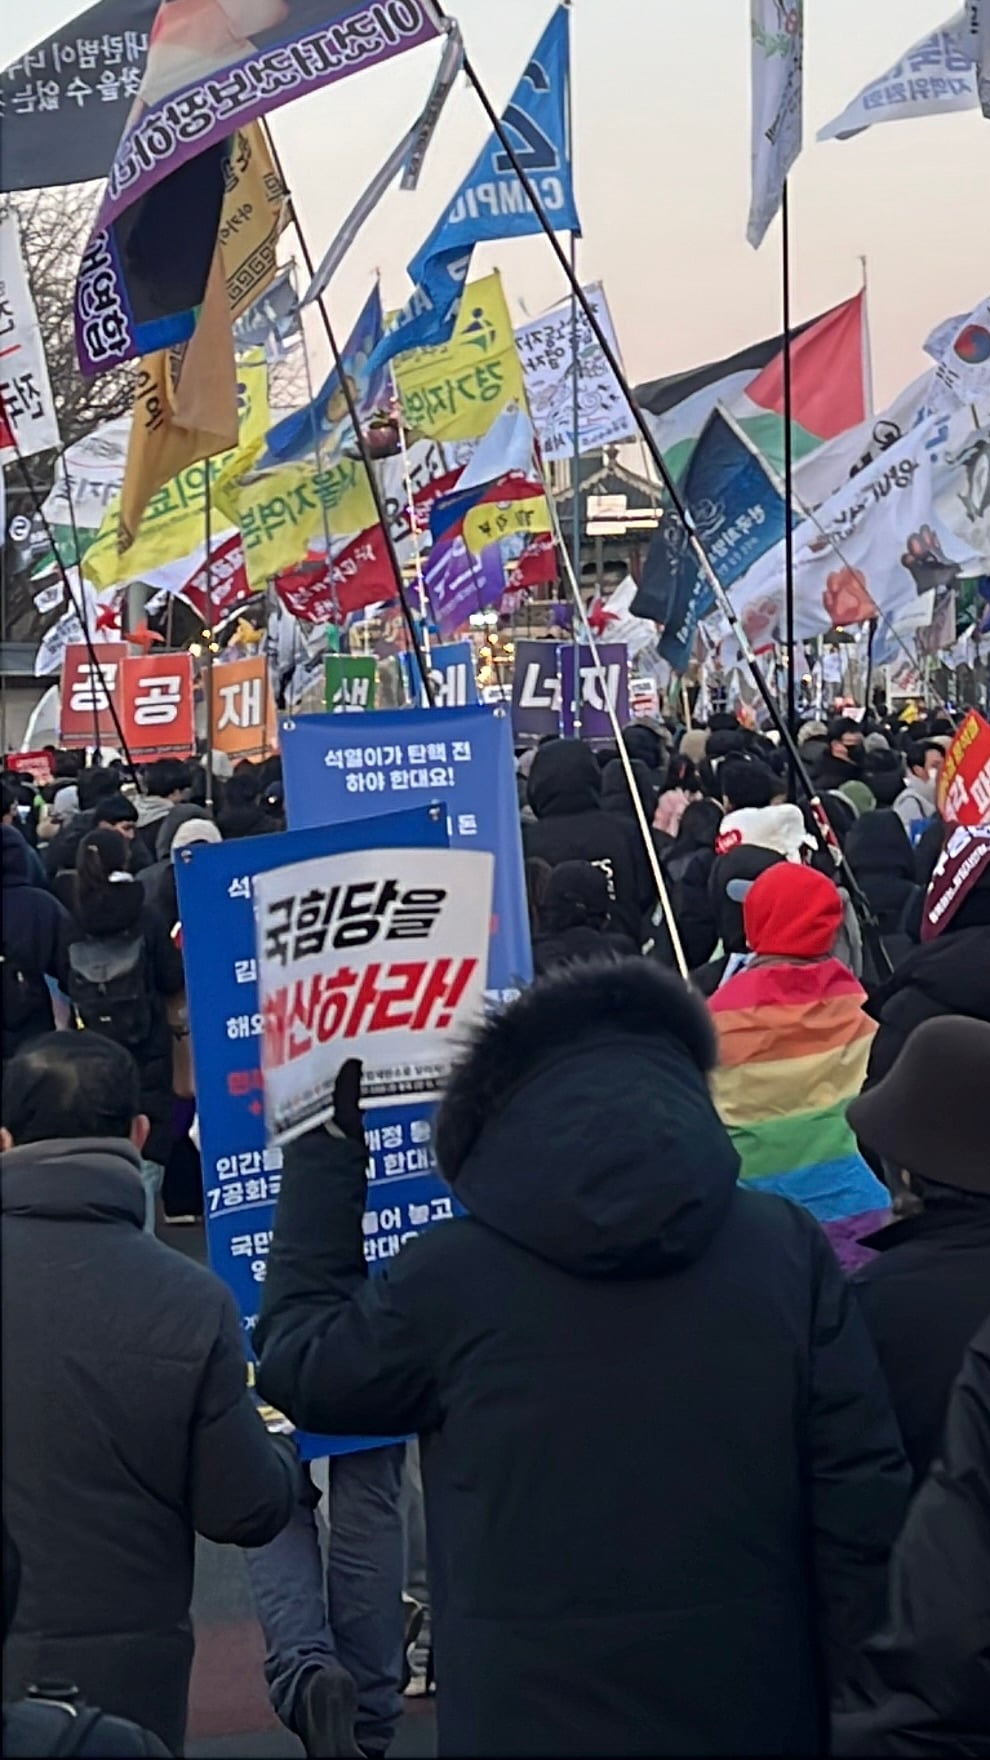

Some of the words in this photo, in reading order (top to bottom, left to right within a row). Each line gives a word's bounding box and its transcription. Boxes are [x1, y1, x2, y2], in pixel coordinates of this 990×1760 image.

[134, 675, 182, 726] 공
[217, 677, 261, 730] 재
[324, 744, 403, 770] 석열이가
[407, 742, 448, 768] 탄핵
[451, 741, 472, 765] 전
[345, 770, 386, 793] 하야
[389, 767, 456, 792] 한대요!
[265, 878, 447, 967] 국힘당을
[264, 957, 478, 1070] 해산하라!
